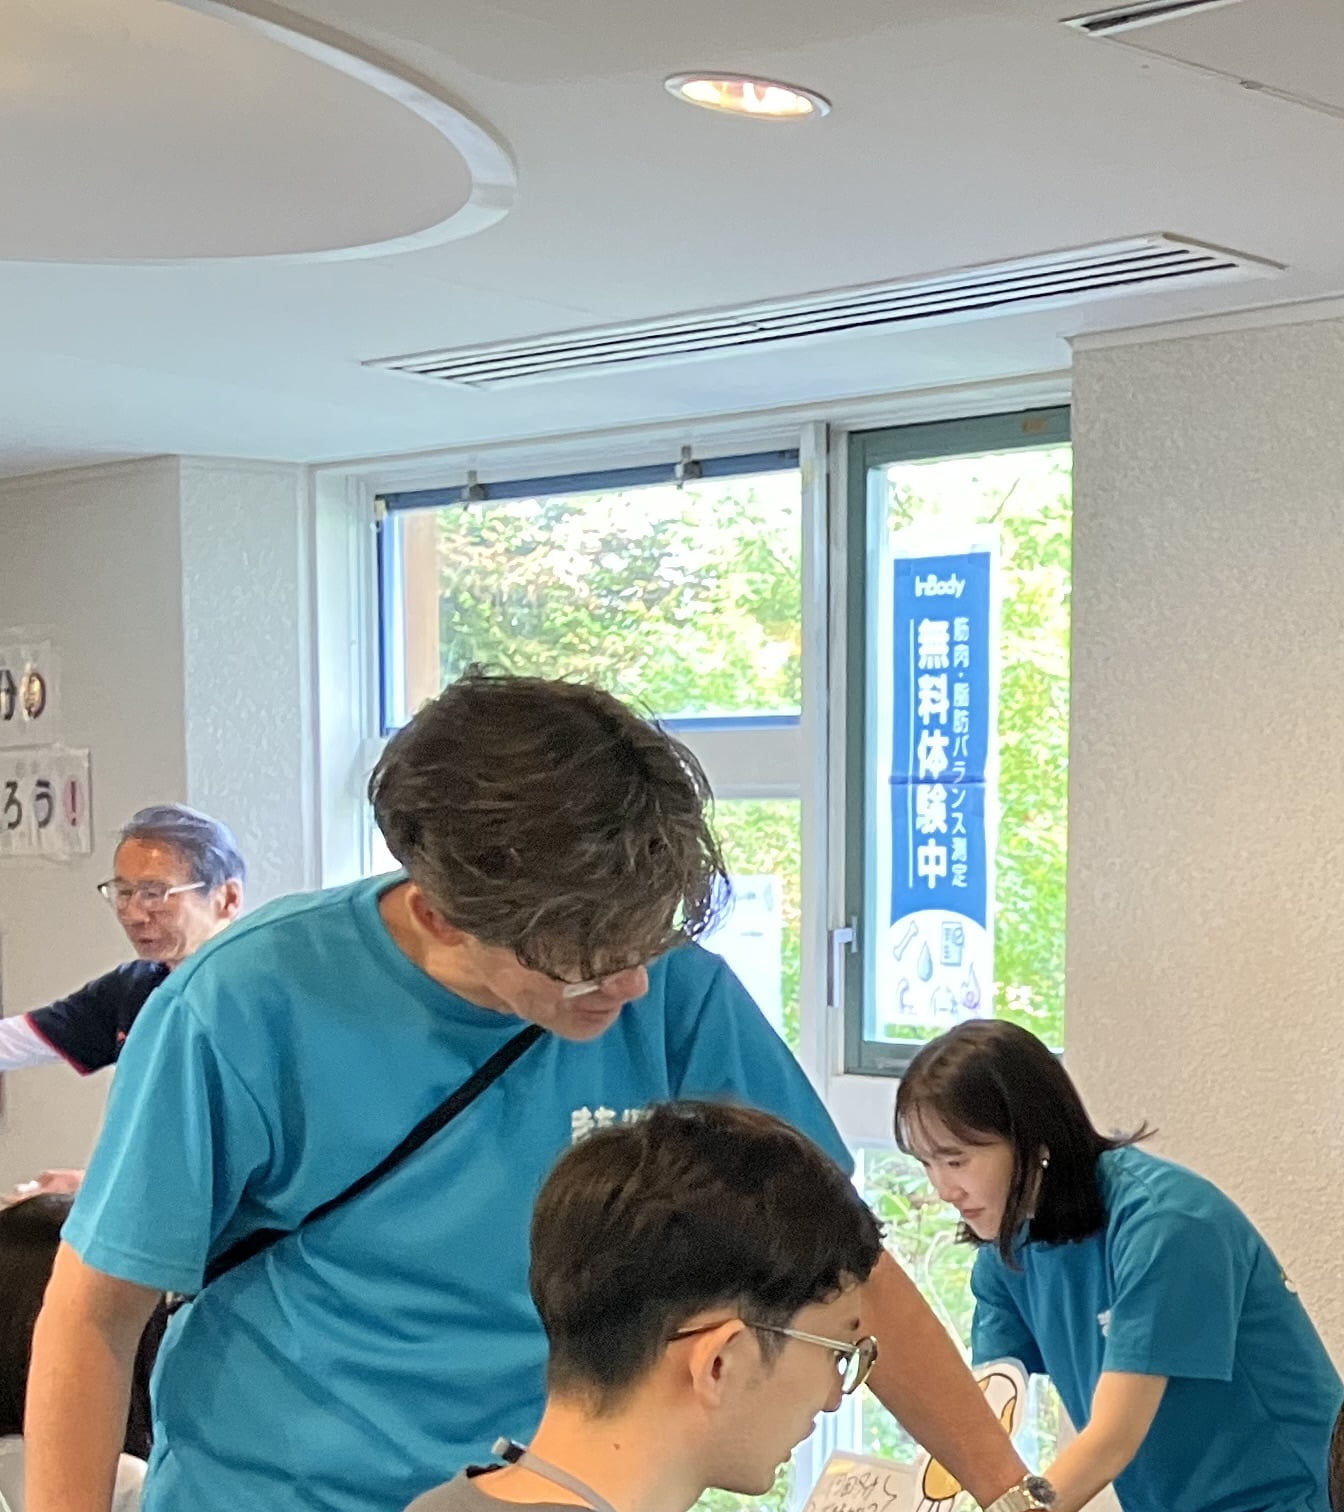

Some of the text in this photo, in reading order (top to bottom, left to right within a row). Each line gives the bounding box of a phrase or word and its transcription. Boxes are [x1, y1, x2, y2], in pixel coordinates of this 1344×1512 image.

[915, 573, 966, 598] InBody
[917, 617, 950, 889] 無料体験中
